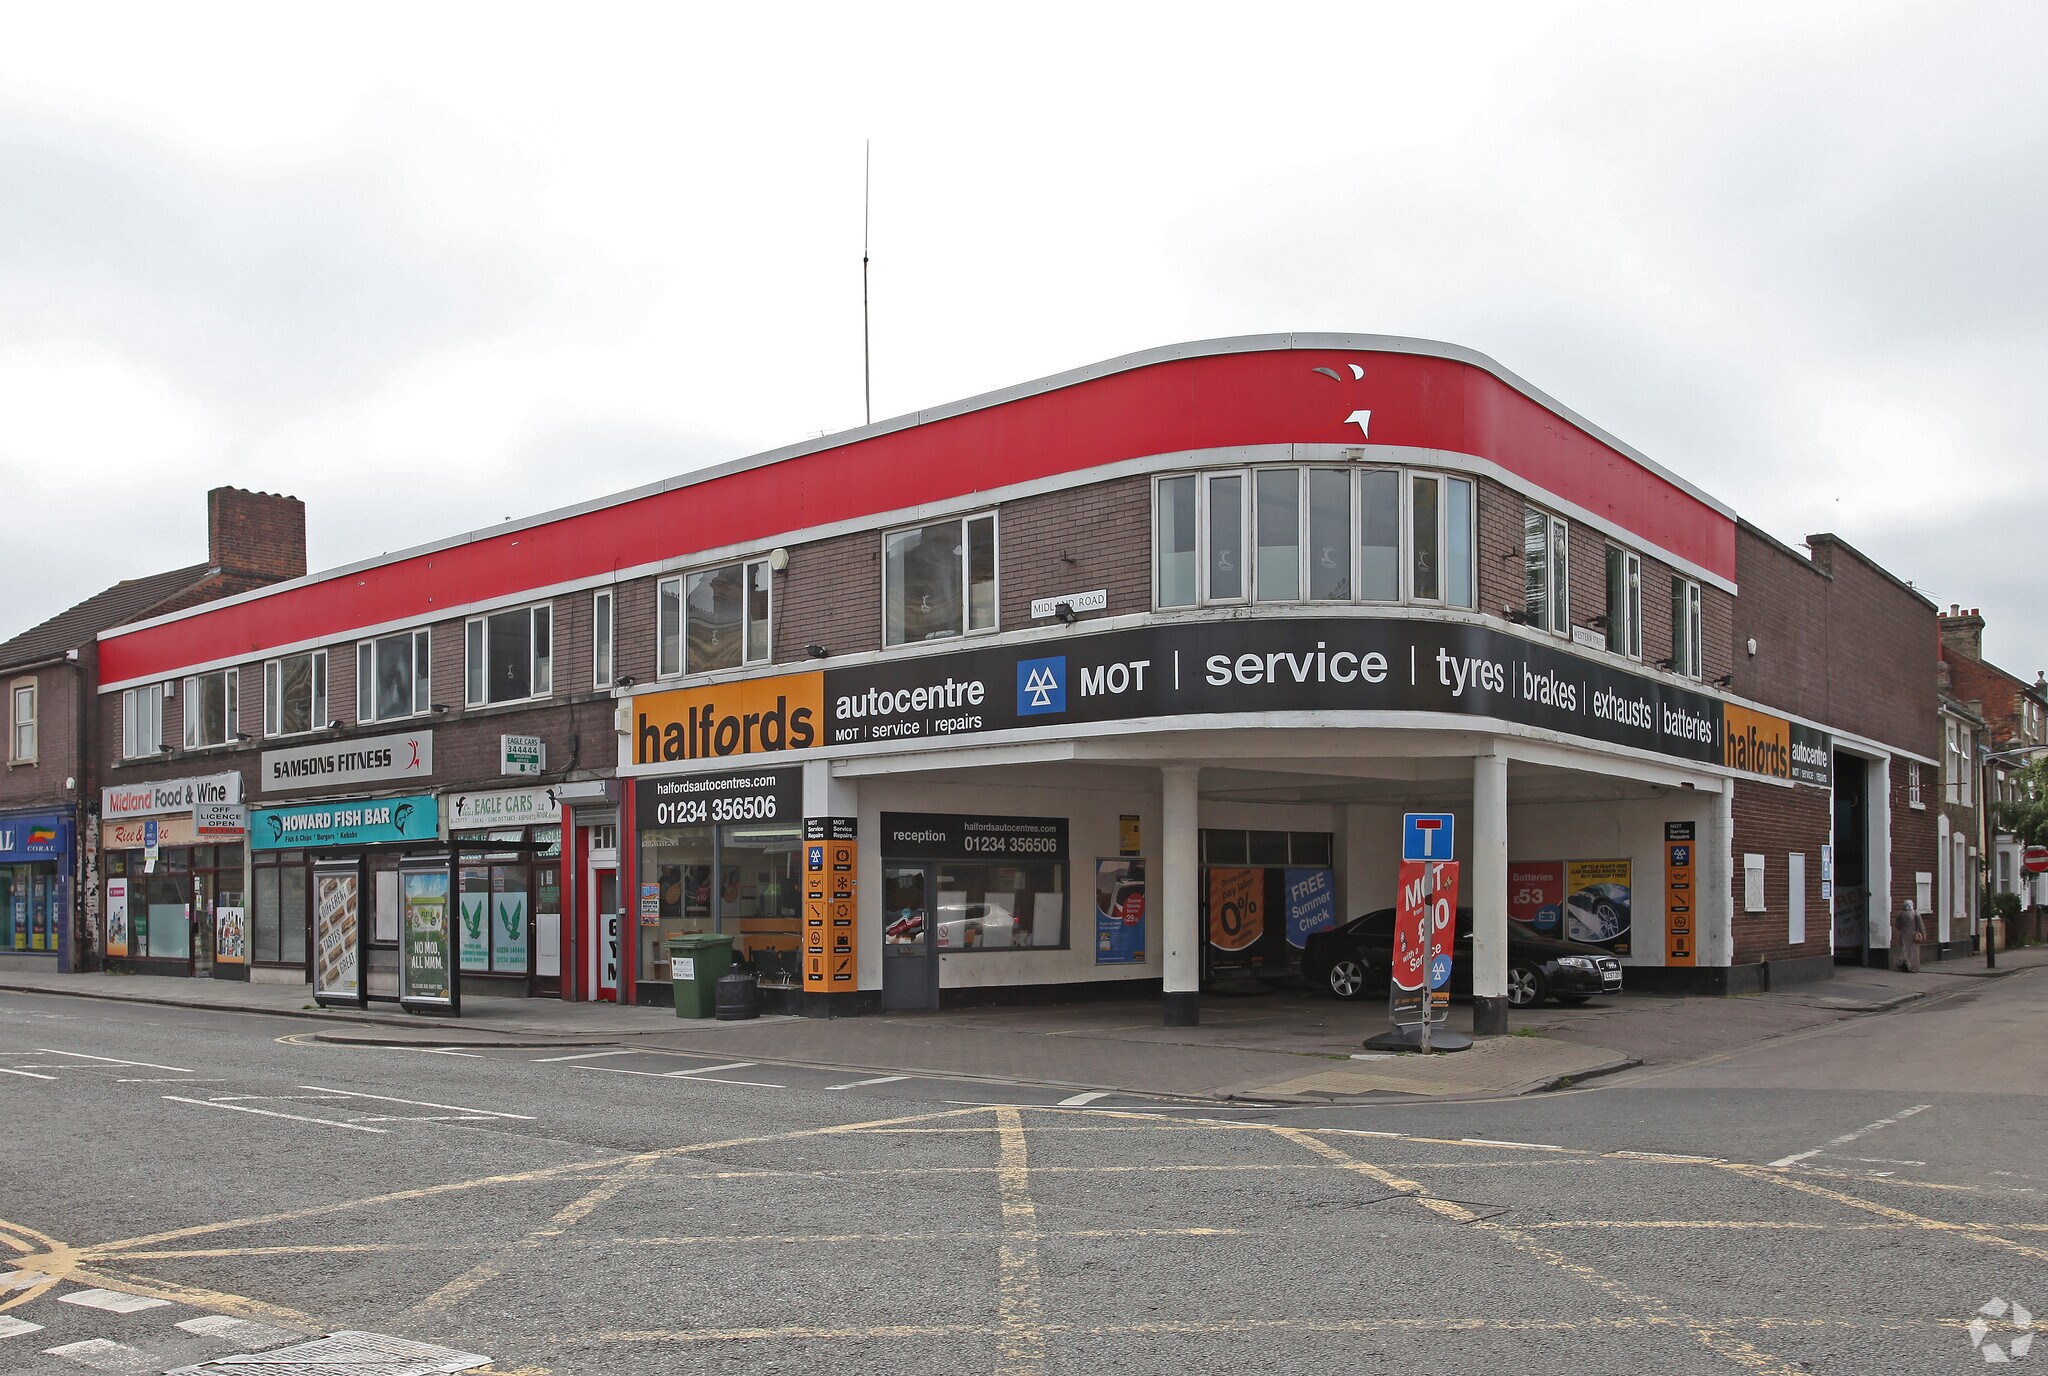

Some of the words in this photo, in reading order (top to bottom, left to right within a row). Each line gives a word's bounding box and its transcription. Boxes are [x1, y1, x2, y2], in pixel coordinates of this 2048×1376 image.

[1033, 599, 1075, 614] MIDLD
[1079, 594, 1104, 606] ROAD
[1205, 641, 1389, 686] service
[1435, 647, 1504, 697] tyres
[1080, 660, 1150, 697] MOT
[1523, 662, 1577, 712] brakes
[835, 677, 985, 720] autocentre
[1593, 686, 1652, 730] exhausts
[639, 695, 815, 764] halfords
[835, 728, 859, 742] MOT
[872, 720, 920, 739] service
[935, 713, 982, 735] repairs
[1663, 702, 1712, 744] batteries
[507, 737, 522, 745] EAGLE
[524, 738, 538, 746] CARS
[507, 746, 538, 754] 344444
[1727, 720, 1788, 779] halfords
[274, 756, 334, 779] SAMSONS
[338, 748, 392, 771] FITNESS
[1792, 741, 1828, 768] autocentre
[657, 774, 776, 795] halfordsautocentres.com
[1791, 767, 1800, 777] MOT
[1801, 768, 1814, 780] service
[1816, 770, 1827, 783] repairs
[109, 789, 152, 813] Midland
[154, 787, 182, 808] Food
[185, 788, 193, 803] &
[197, 784, 226, 803] Wine
[474, 797, 502, 816] EAGLE
[505, 794, 533, 813] CARS
[657, 799, 708, 825] 01234
[711, 794, 777, 821] 356506
[282, 813, 331, 831] HOWARD
[335, 810, 361, 827] FISH
[365, 807, 391, 825] BAR
[964, 821, 1057, 834] halfordsautocentres.com
[114, 826, 137, 843] Rice
[136, 827, 144, 842] &
[299, 834, 312, 842] Chips
[317, 832, 335, 841] Burgers
[340, 831, 358, 839] Kebabs
[893, 829, 946, 844] reception
[964, 836, 1006, 852] 01234
[1009, 837, 1057, 853] 356506
[1222, 888, 1236, 902] pay
[1237, 877, 1255, 892] later
[1291, 872, 1326, 902] FREE
[1513, 873, 1553, 882] Batteries
[321, 886, 348, 918] DIFFERENT
[1292, 890, 1331, 919] Summer
[1514, 889, 1543, 904] £53
[1221, 892, 1257, 937] 0%
[1299, 908, 1330, 932] Check
[323, 928, 341, 952] TASTES
[414, 942, 424, 954] NO
[425, 942, 440, 956] MOO,
[339, 952, 356, 975] GREAT
[411, 958, 424, 969] ALL
[424, 956, 443, 969] MMM.
[1402, 949, 1414, 963] with
[1410, 942, 1442, 972] Serce
